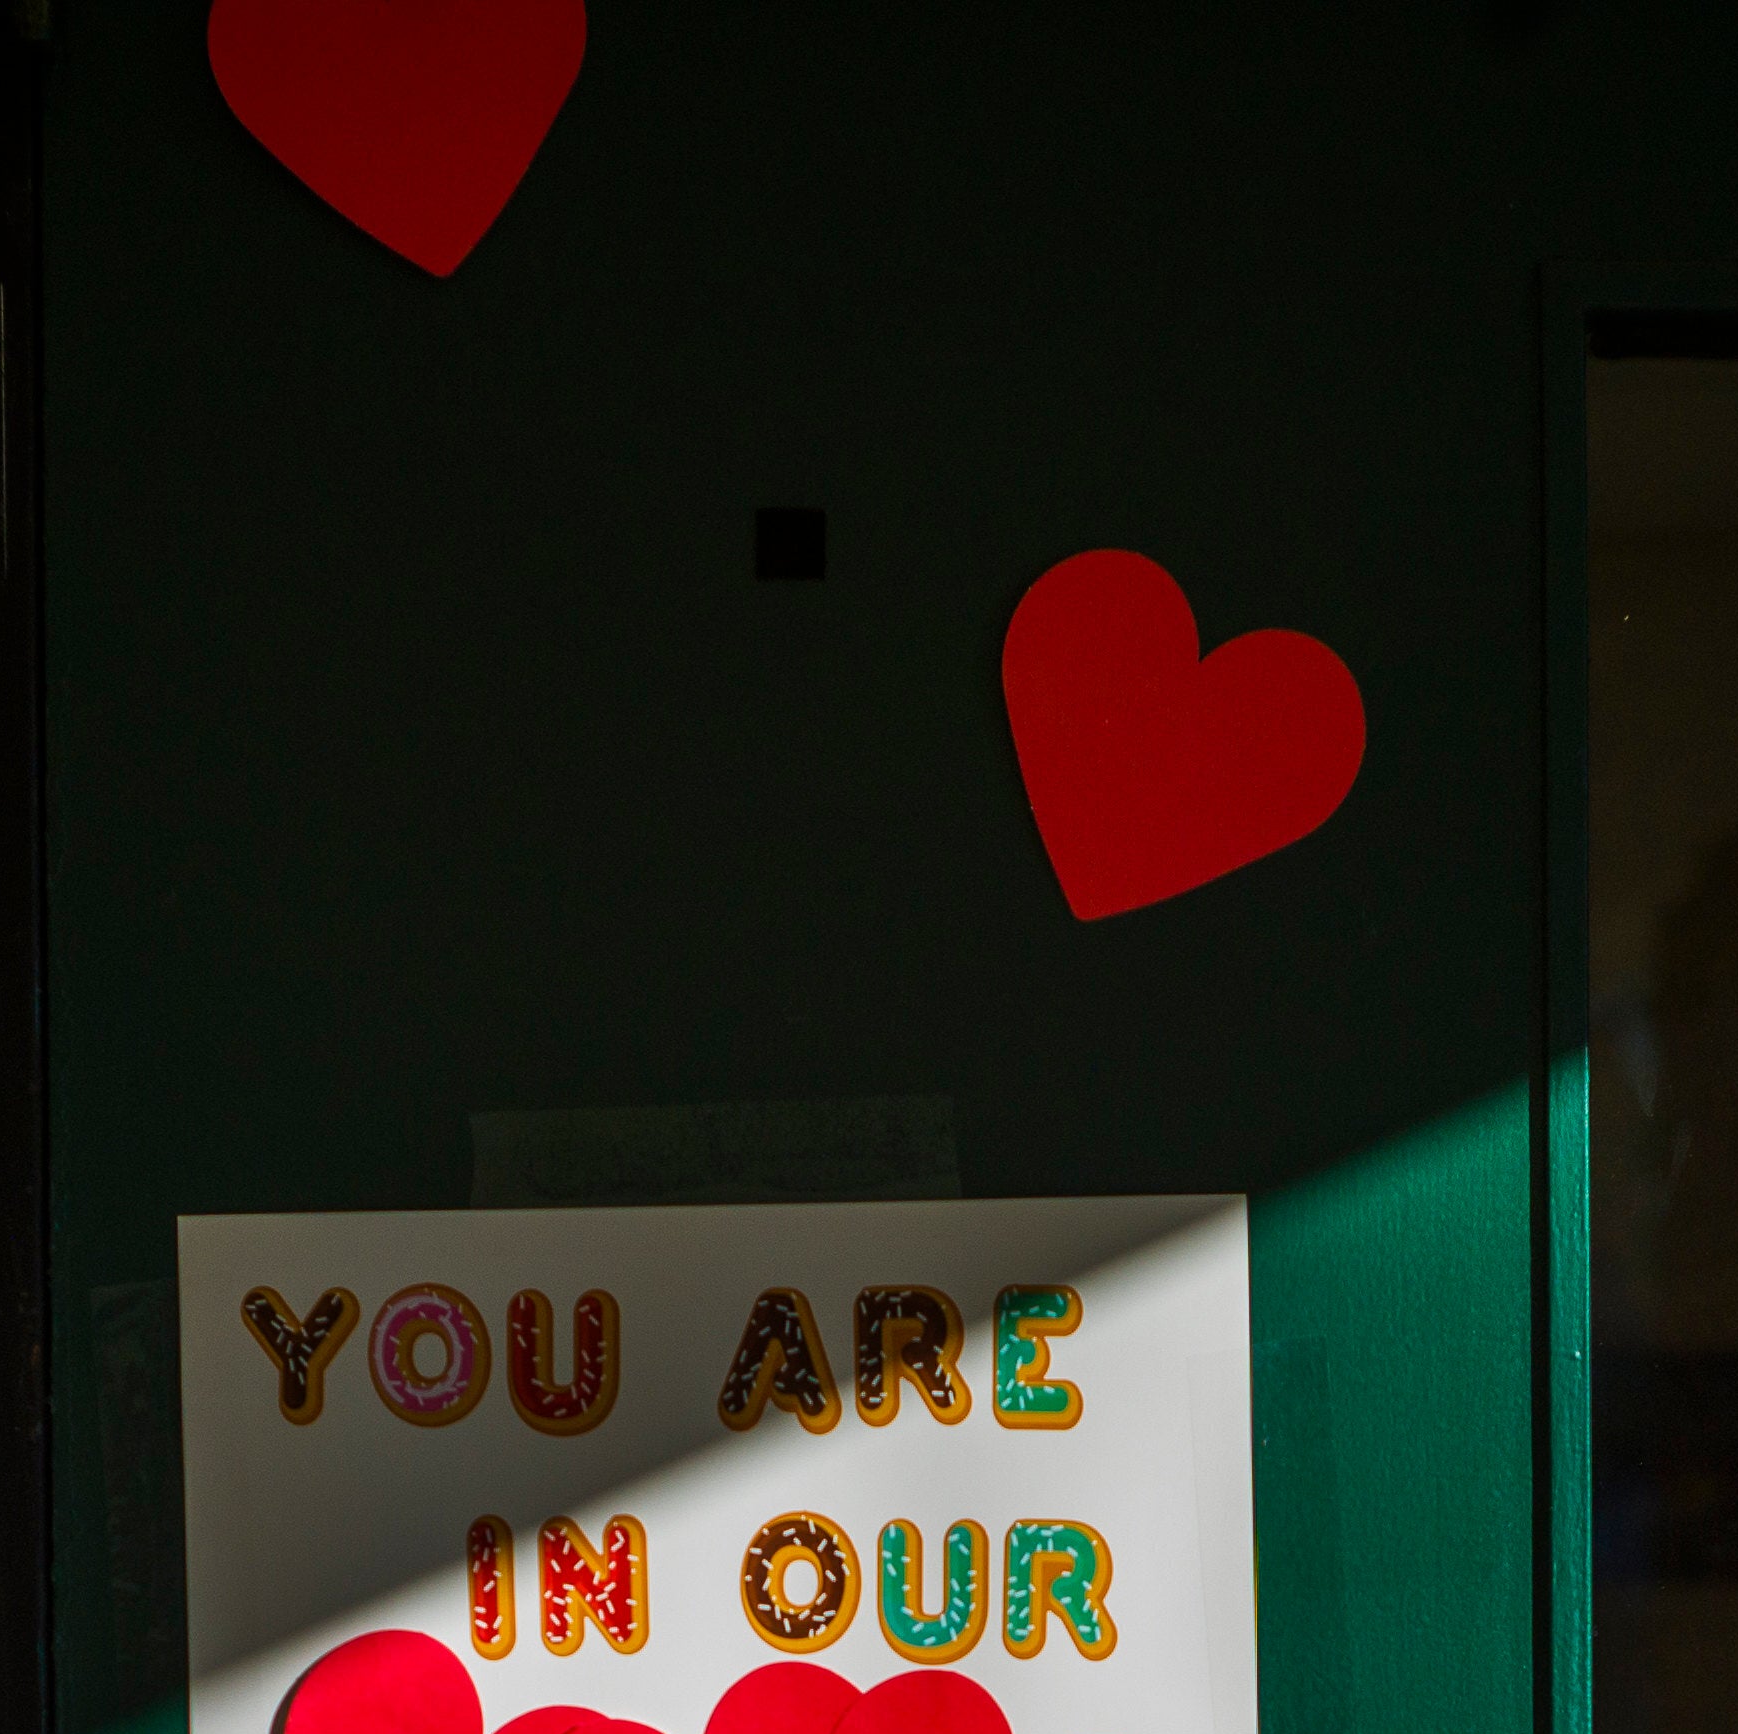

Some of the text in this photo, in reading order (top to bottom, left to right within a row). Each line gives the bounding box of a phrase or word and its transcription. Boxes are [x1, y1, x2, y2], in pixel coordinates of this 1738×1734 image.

[240, 1282, 1084, 1438] YOU ARE
[466, 1511, 1118, 1666] IN OUR
